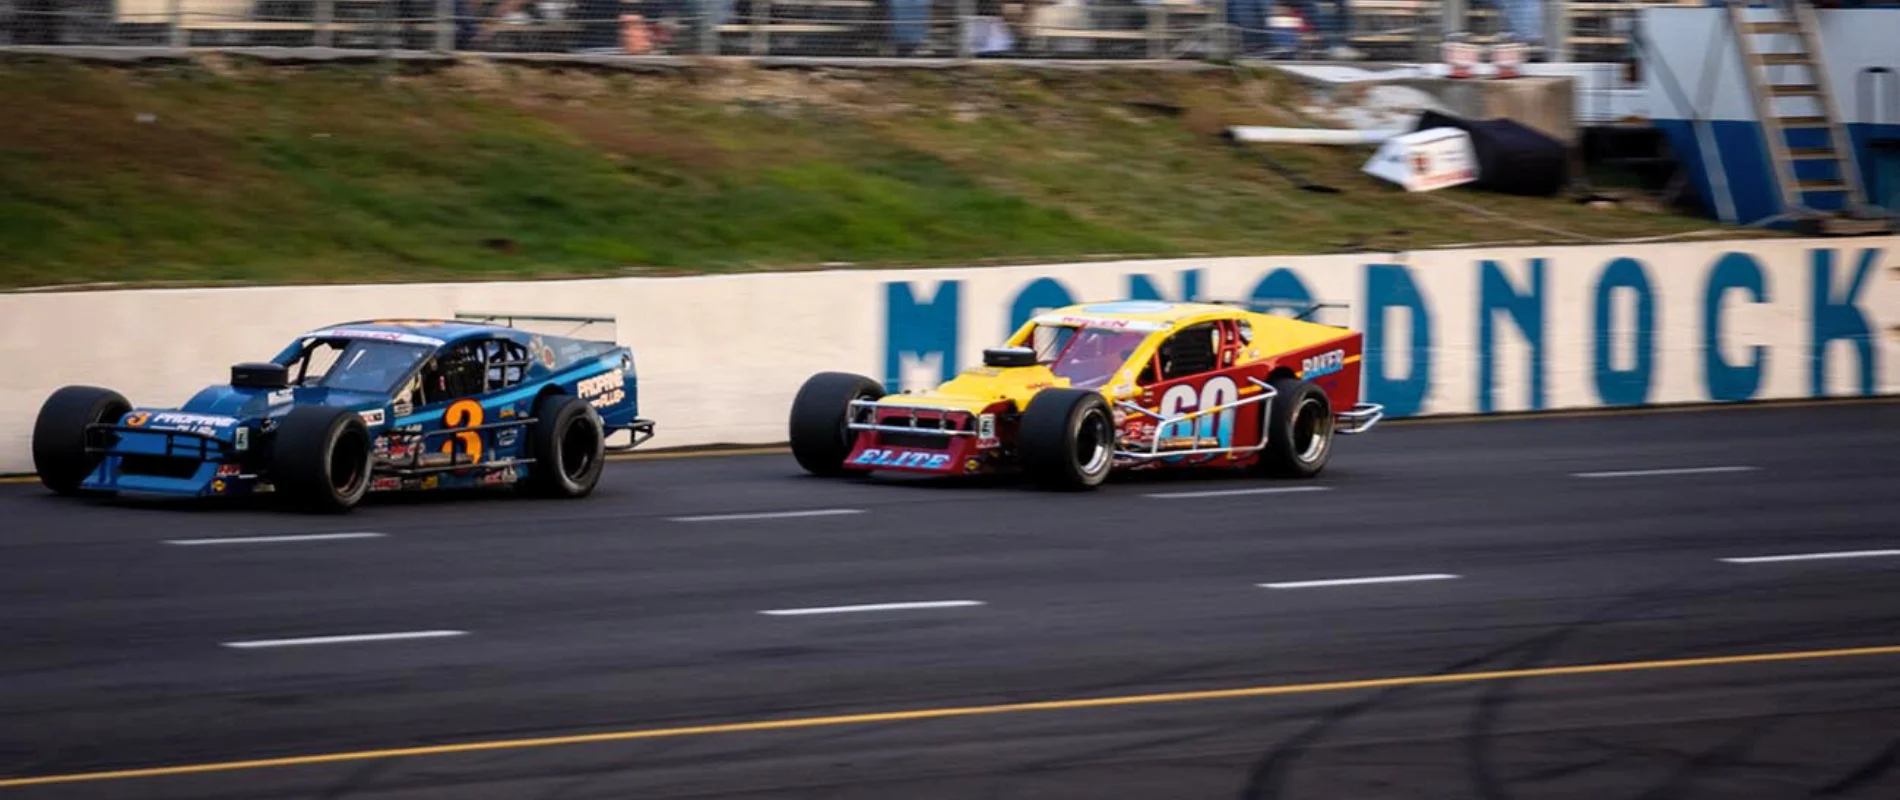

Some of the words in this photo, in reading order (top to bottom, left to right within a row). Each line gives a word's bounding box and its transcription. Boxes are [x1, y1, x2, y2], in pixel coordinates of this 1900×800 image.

[883, 247, 1886, 417] MDNOCK
[577, 368, 624, 399] PROPANE
[1302, 349, 1345, 382] BAKER
[441, 397, 485, 474] 3
[1158, 375, 1239, 463] 60
[854, 448, 951, 469] ELITE
